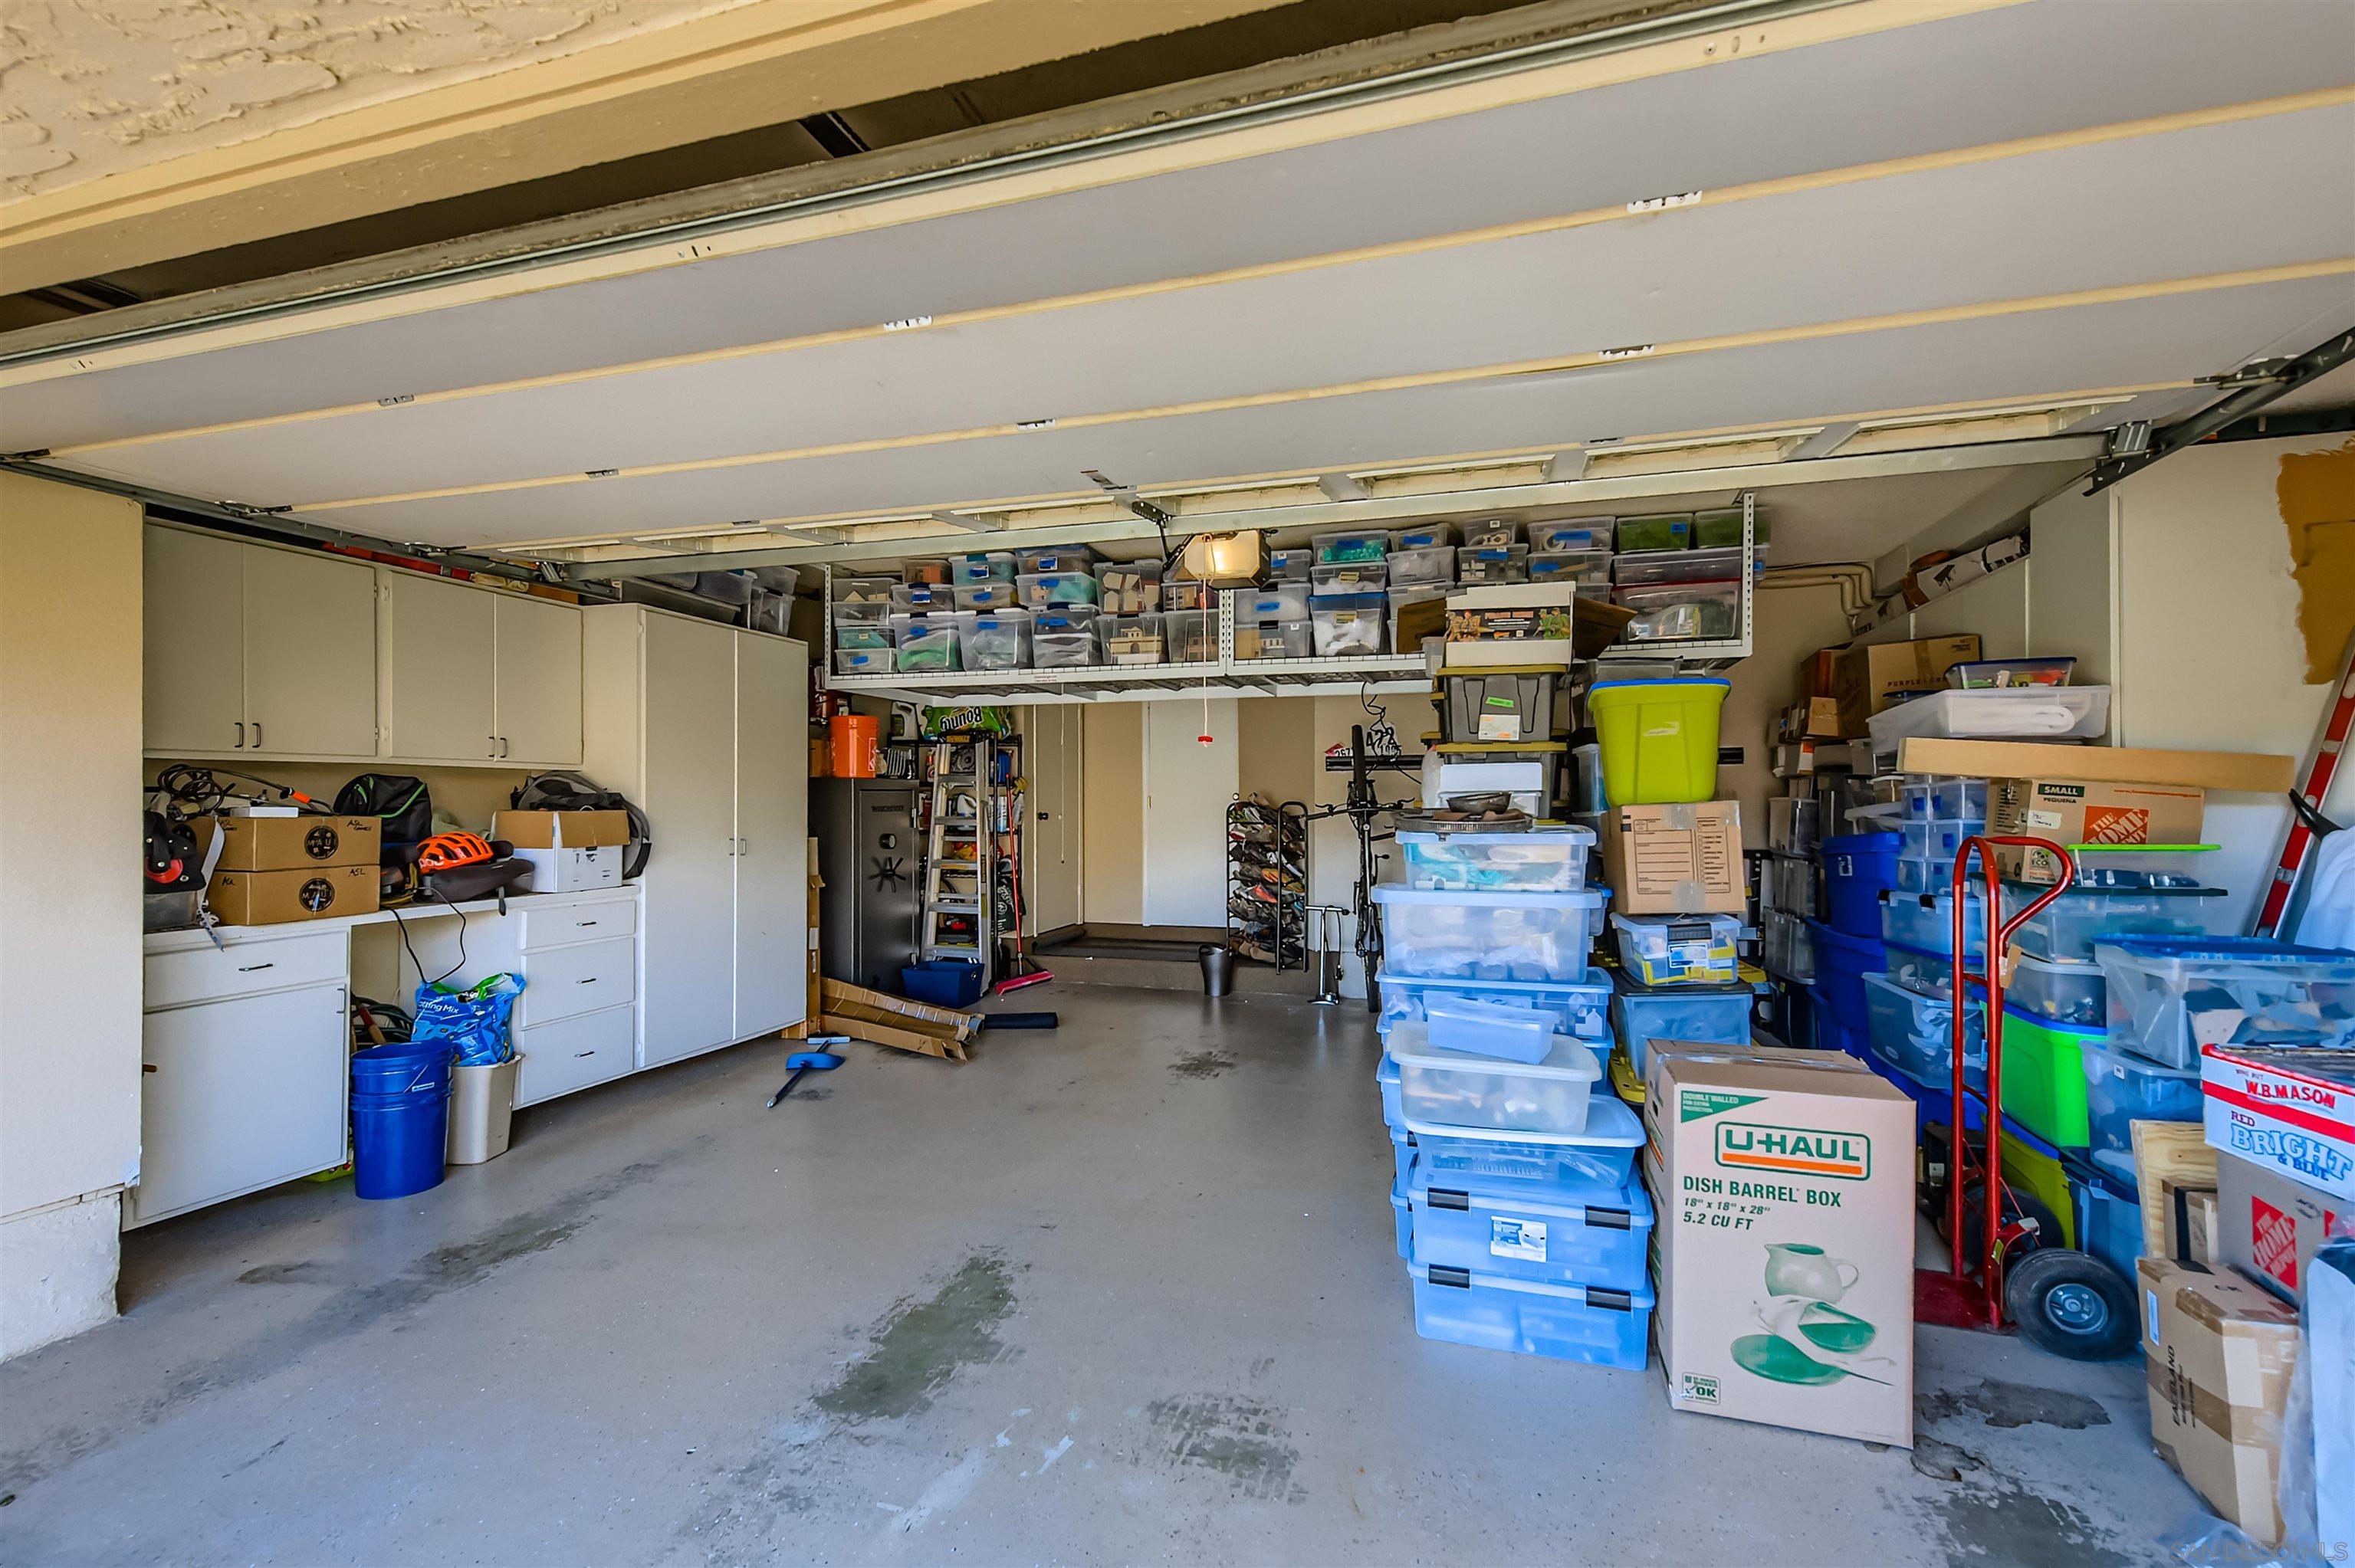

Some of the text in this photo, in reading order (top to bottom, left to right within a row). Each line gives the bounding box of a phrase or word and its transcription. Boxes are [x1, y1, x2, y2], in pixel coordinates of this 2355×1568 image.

[941, 706, 983, 731] Bounty
[2044, 786, 2078, 795] SMALL
[2089, 812, 2117, 832] THE
[307, 838, 337, 846] MAUI
[348, 868, 366, 878] ASL
[442, 1004, 460, 1014] Mix
[1710, 1094, 1739, 1104] WALLED
[2231, 1110, 2255, 1127] RED
[1726, 1129, 1861, 1162] U-HAUL
[2231, 1122, 2353, 1182] BRIGHT
[2278, 1153, 2330, 1182] & BLUE
[1683, 1176, 1842, 1208] DISH BARREL BOX
[1683, 1211, 1754, 1230] 5.2 CU FT
[1696, 1386, 1716, 1398] OK
